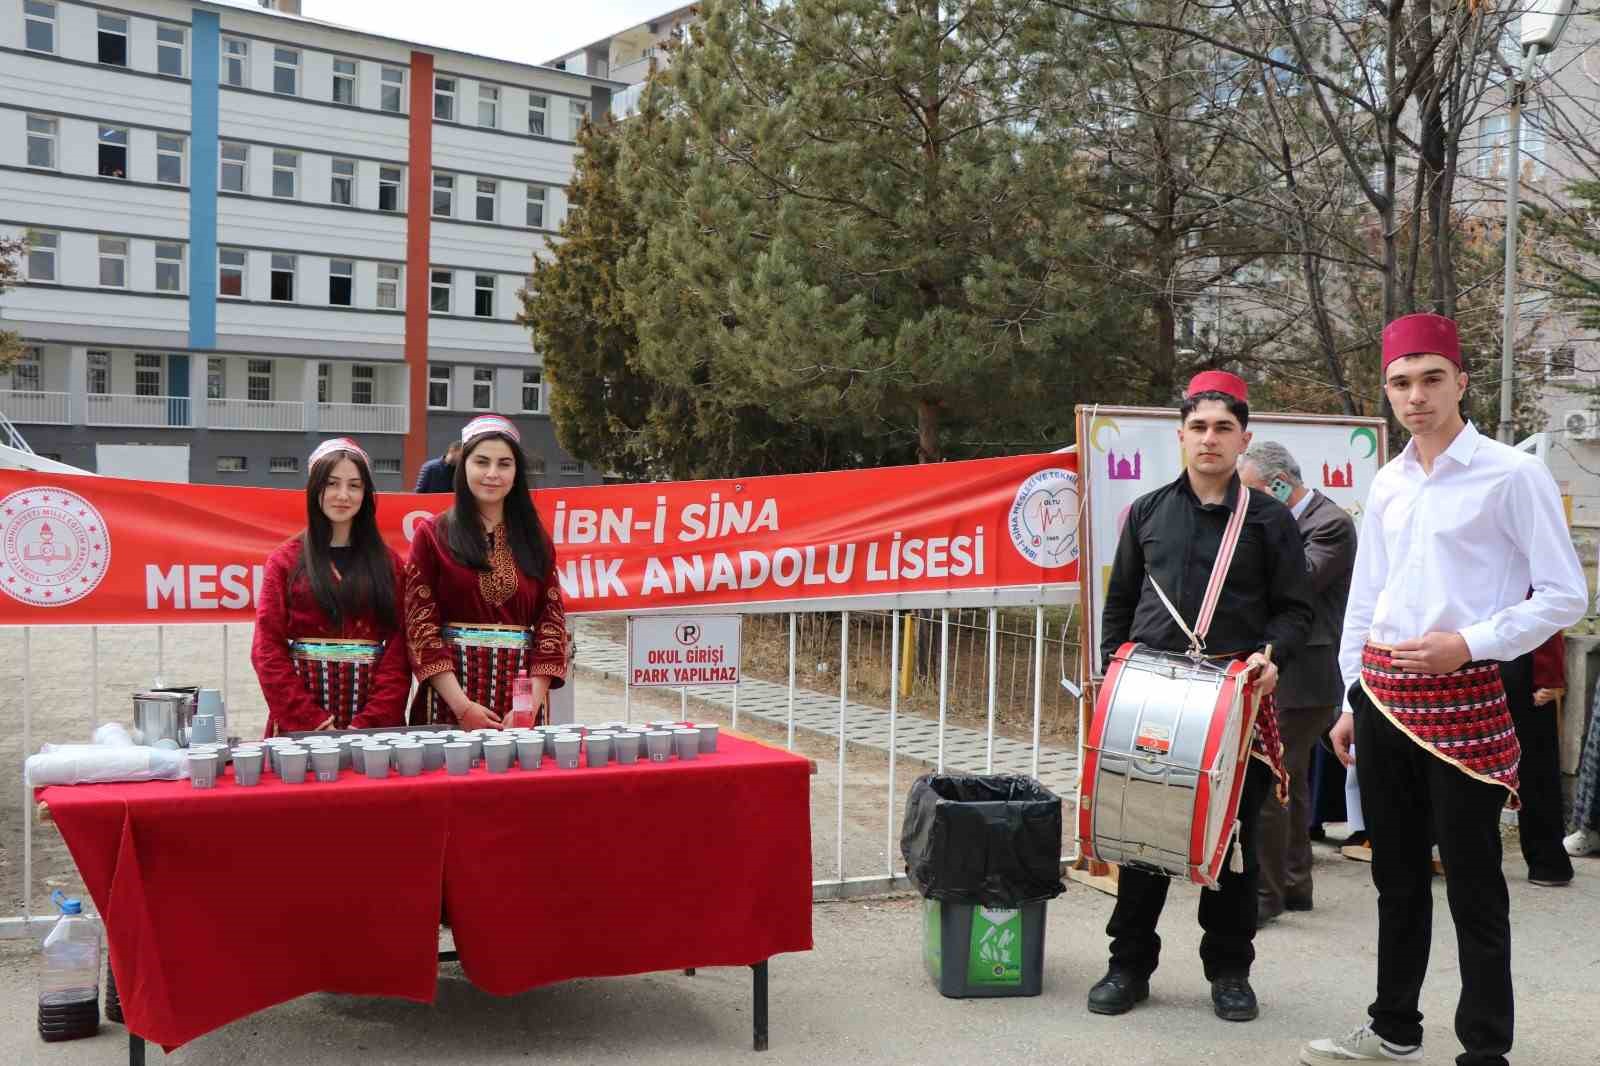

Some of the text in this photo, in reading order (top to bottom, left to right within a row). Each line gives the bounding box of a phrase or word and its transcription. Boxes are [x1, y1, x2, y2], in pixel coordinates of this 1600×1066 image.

[553, 492, 779, 544] İBN-İ SİNA
[640, 543, 856, 596] ANADOLU
[866, 525, 984, 581] LİSESİ
[648, 645, 724, 666] OKUL GİRİŞİ
[634, 667, 736, 683] PARK YAPILMAZ
